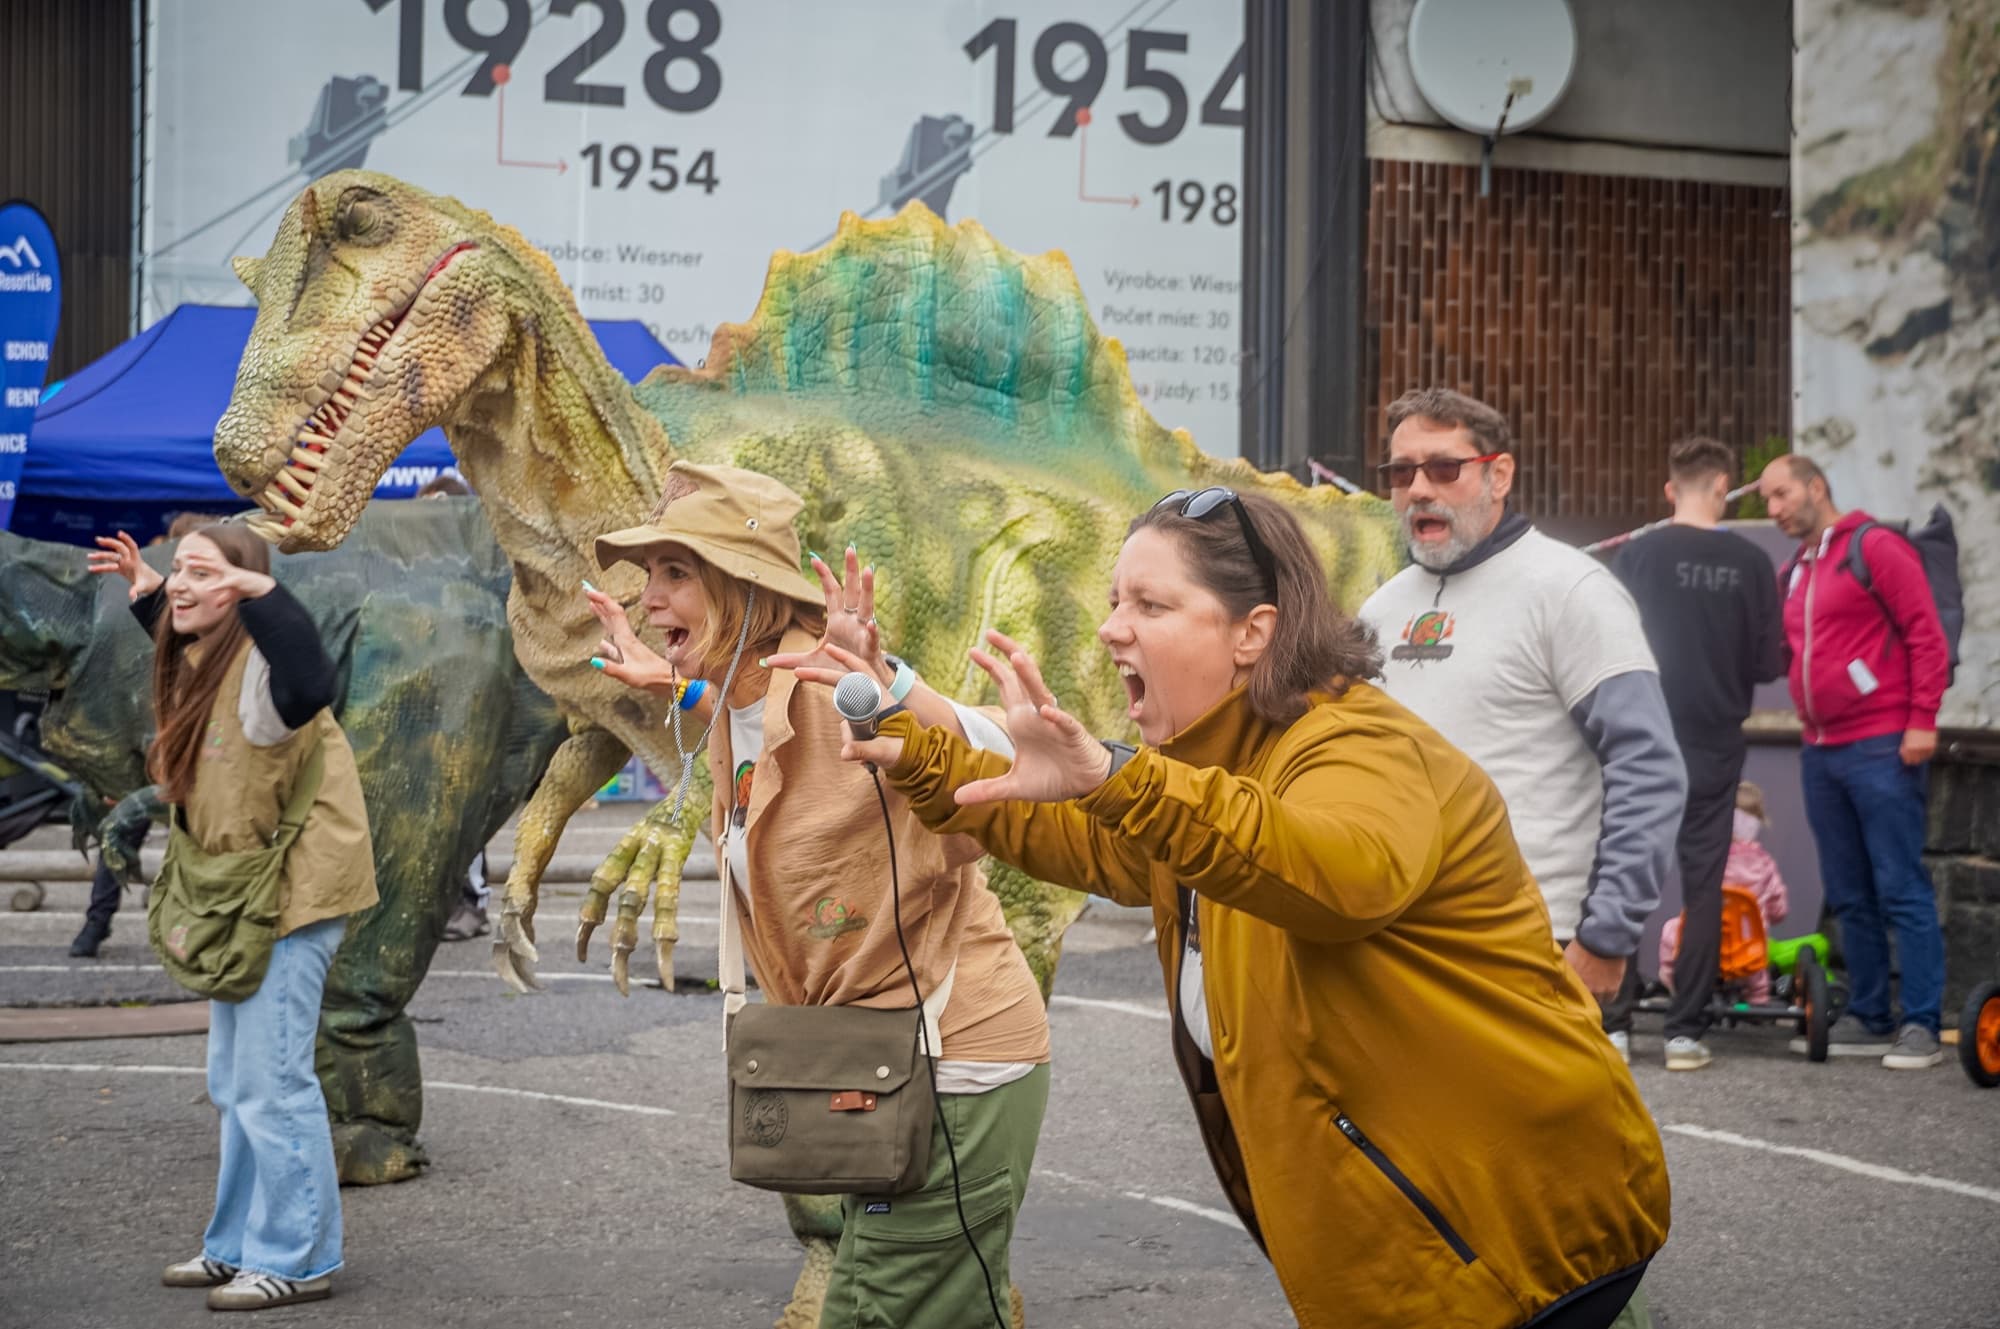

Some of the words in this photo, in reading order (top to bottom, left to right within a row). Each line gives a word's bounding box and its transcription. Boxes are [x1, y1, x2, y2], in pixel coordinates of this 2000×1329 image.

[361, 0, 723, 115] 1928
[580, 143, 720, 195] 1954
[1152, 179, 1238, 227] 198
[617, 243, 704, 268] Wiesner
[637, 282, 665, 304] 30
[1207, 309, 1230, 330] 30
[1193, 346, 1226, 366] 120
[6, 387, 40, 408] RENT
[1209, 381, 1231, 402] 15
[1675, 560, 1741, 592] STAFF
